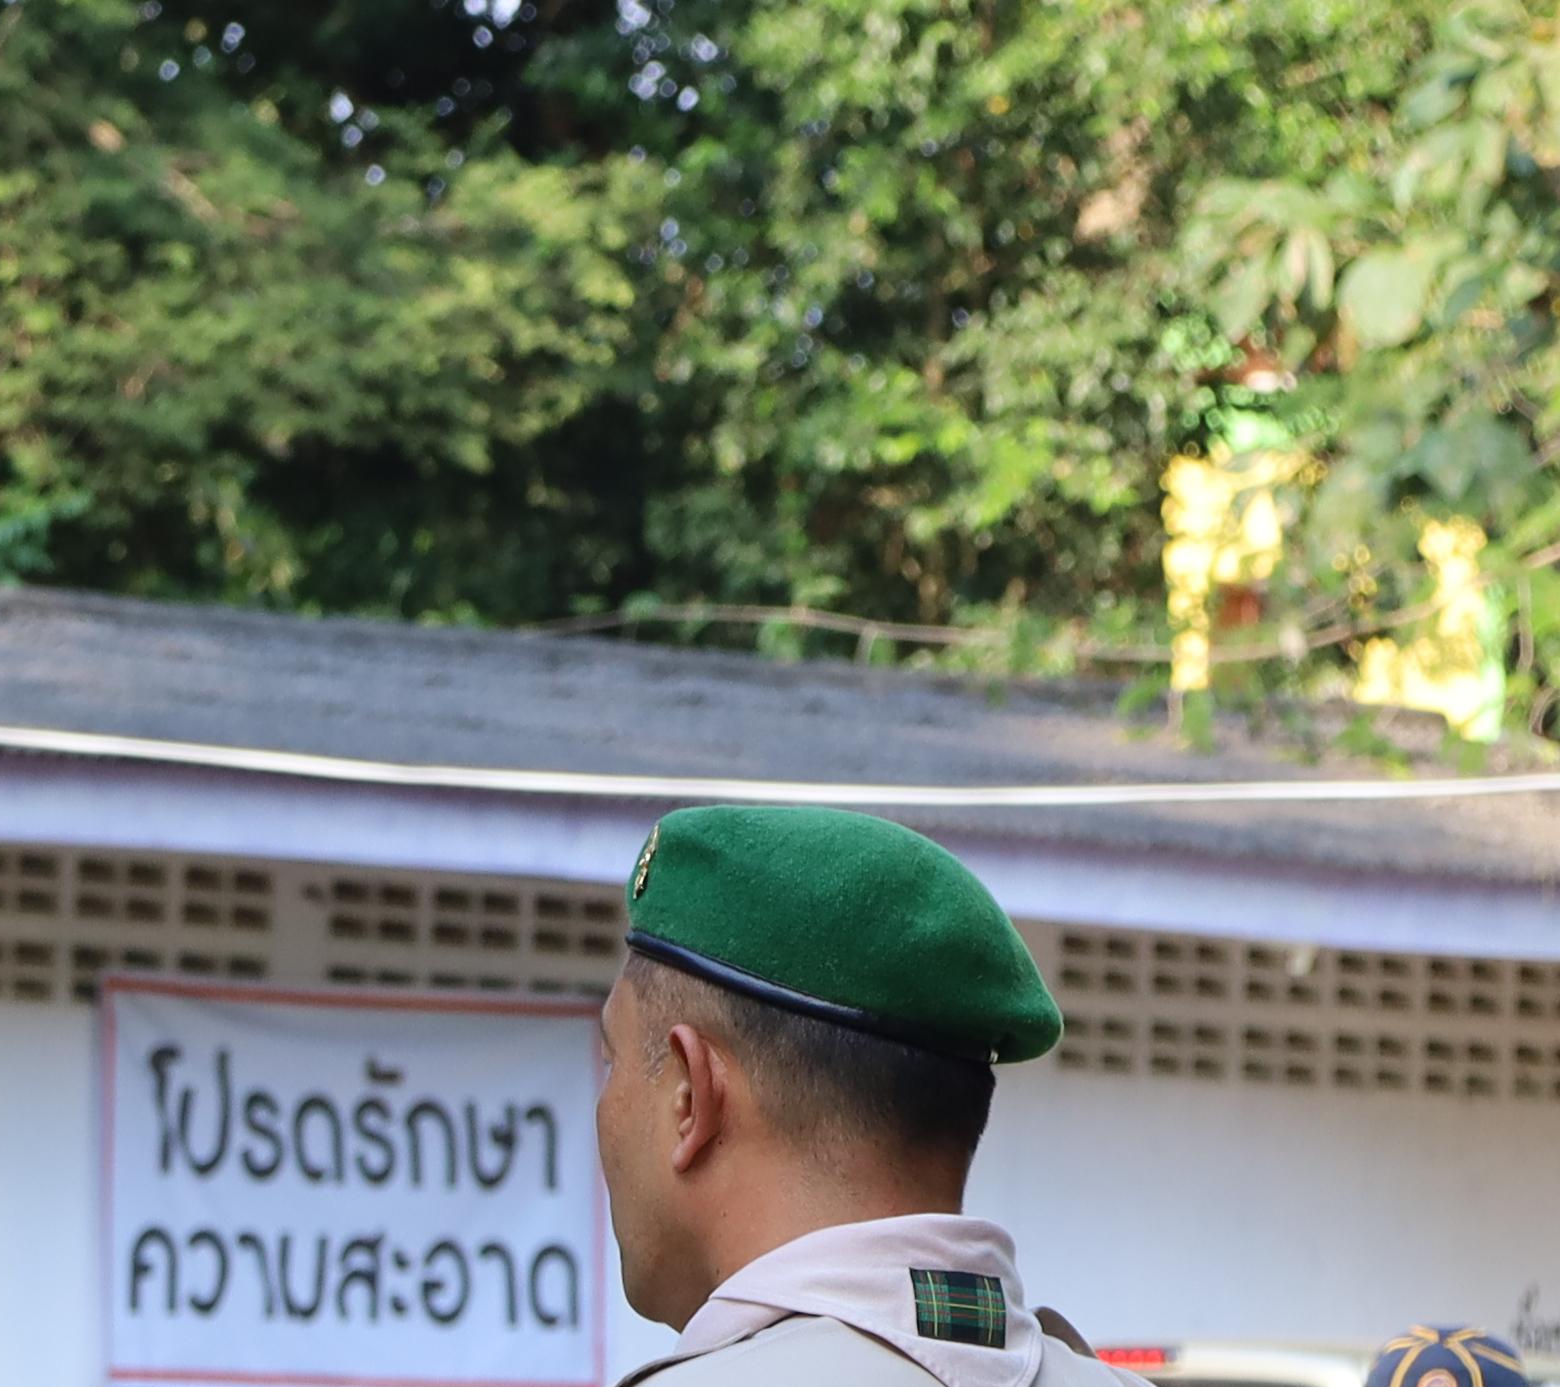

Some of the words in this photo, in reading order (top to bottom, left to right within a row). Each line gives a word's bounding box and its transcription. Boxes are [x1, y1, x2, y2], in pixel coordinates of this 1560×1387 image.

[149, 1043, 561, 1192] โปรดรักษา
[128, 1226, 581, 1331] ความสะอาด
